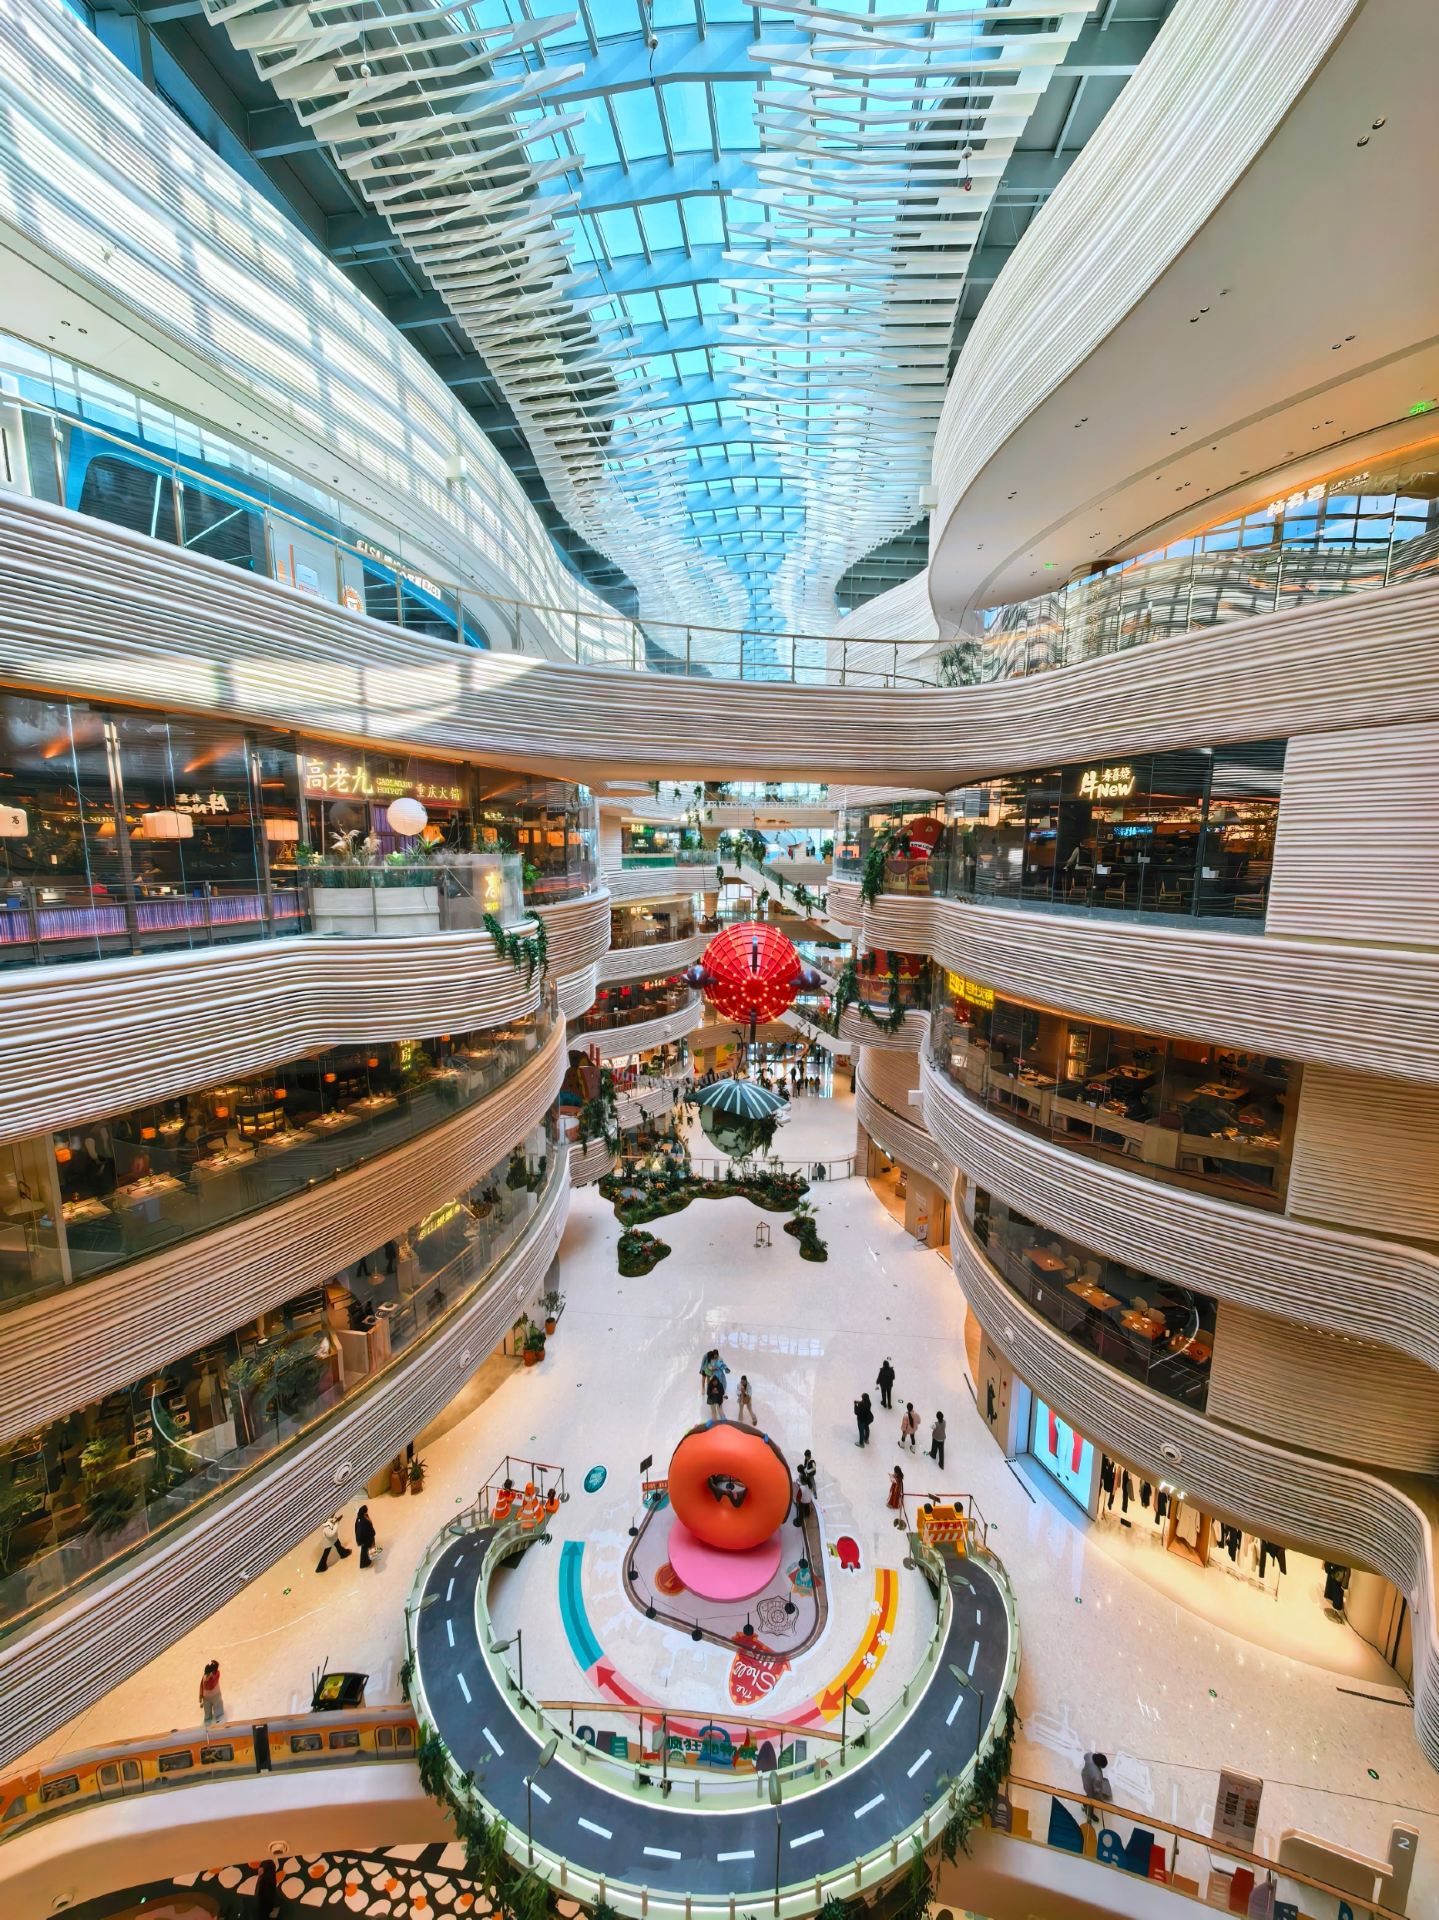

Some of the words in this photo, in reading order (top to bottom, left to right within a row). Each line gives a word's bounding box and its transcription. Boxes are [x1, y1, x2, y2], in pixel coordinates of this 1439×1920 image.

[306, 759, 374, 794] 高老九
[377, 786, 404, 796] HOTPOT
[415, 783, 462, 801] 重庆火锅
[734, 1661, 776, 1693] Shell
[736, 1684, 752, 1699] The
[1398, 1837, 1410, 1849] 2
